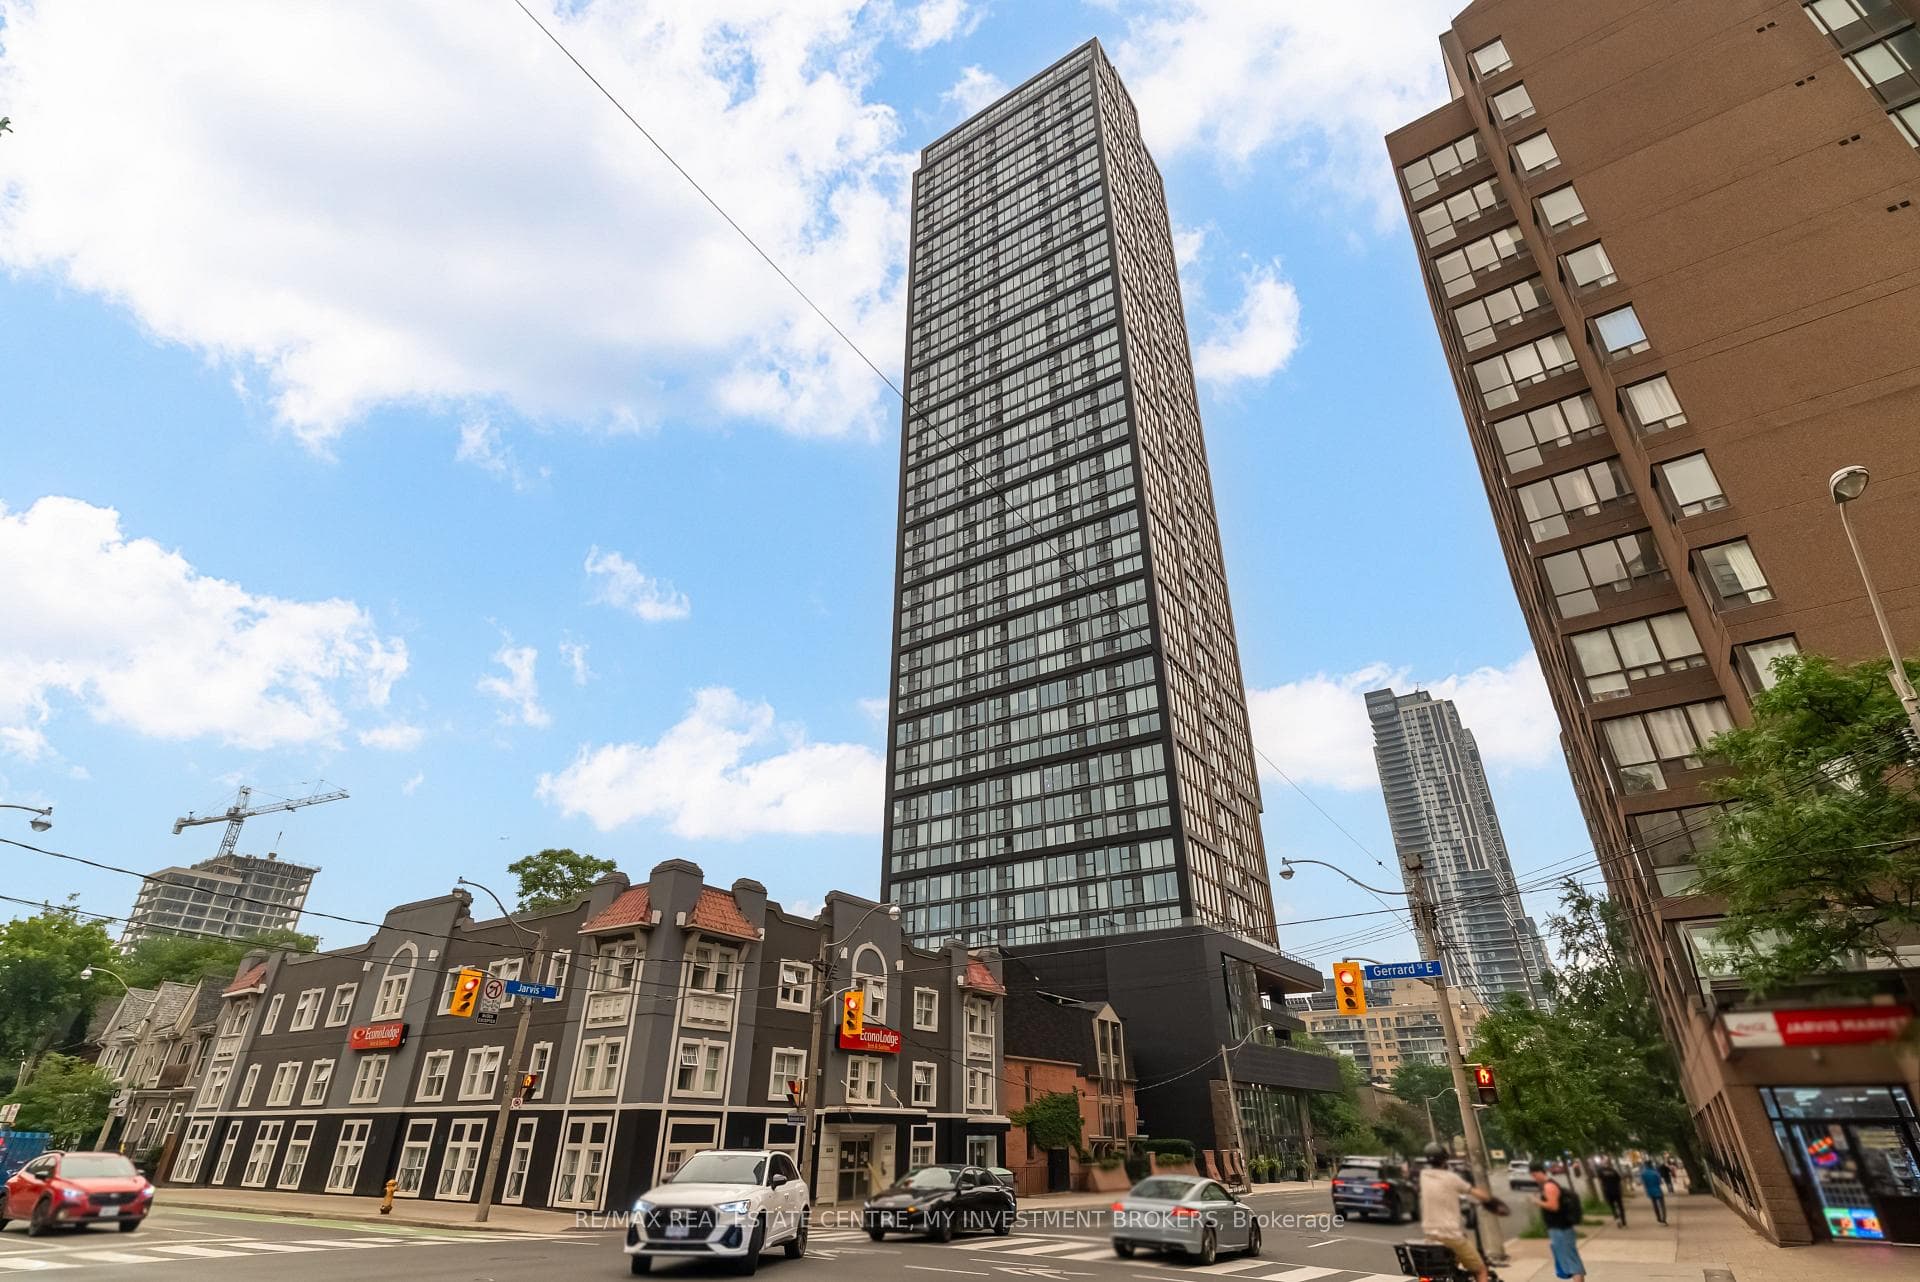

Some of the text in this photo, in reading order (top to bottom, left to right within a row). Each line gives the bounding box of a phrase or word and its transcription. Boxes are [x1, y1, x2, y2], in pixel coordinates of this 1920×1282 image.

[1373, 963, 1416, 977] Gerrard
[1425, 962, 1434, 973] E
[517, 983, 540, 995] Jarvis
